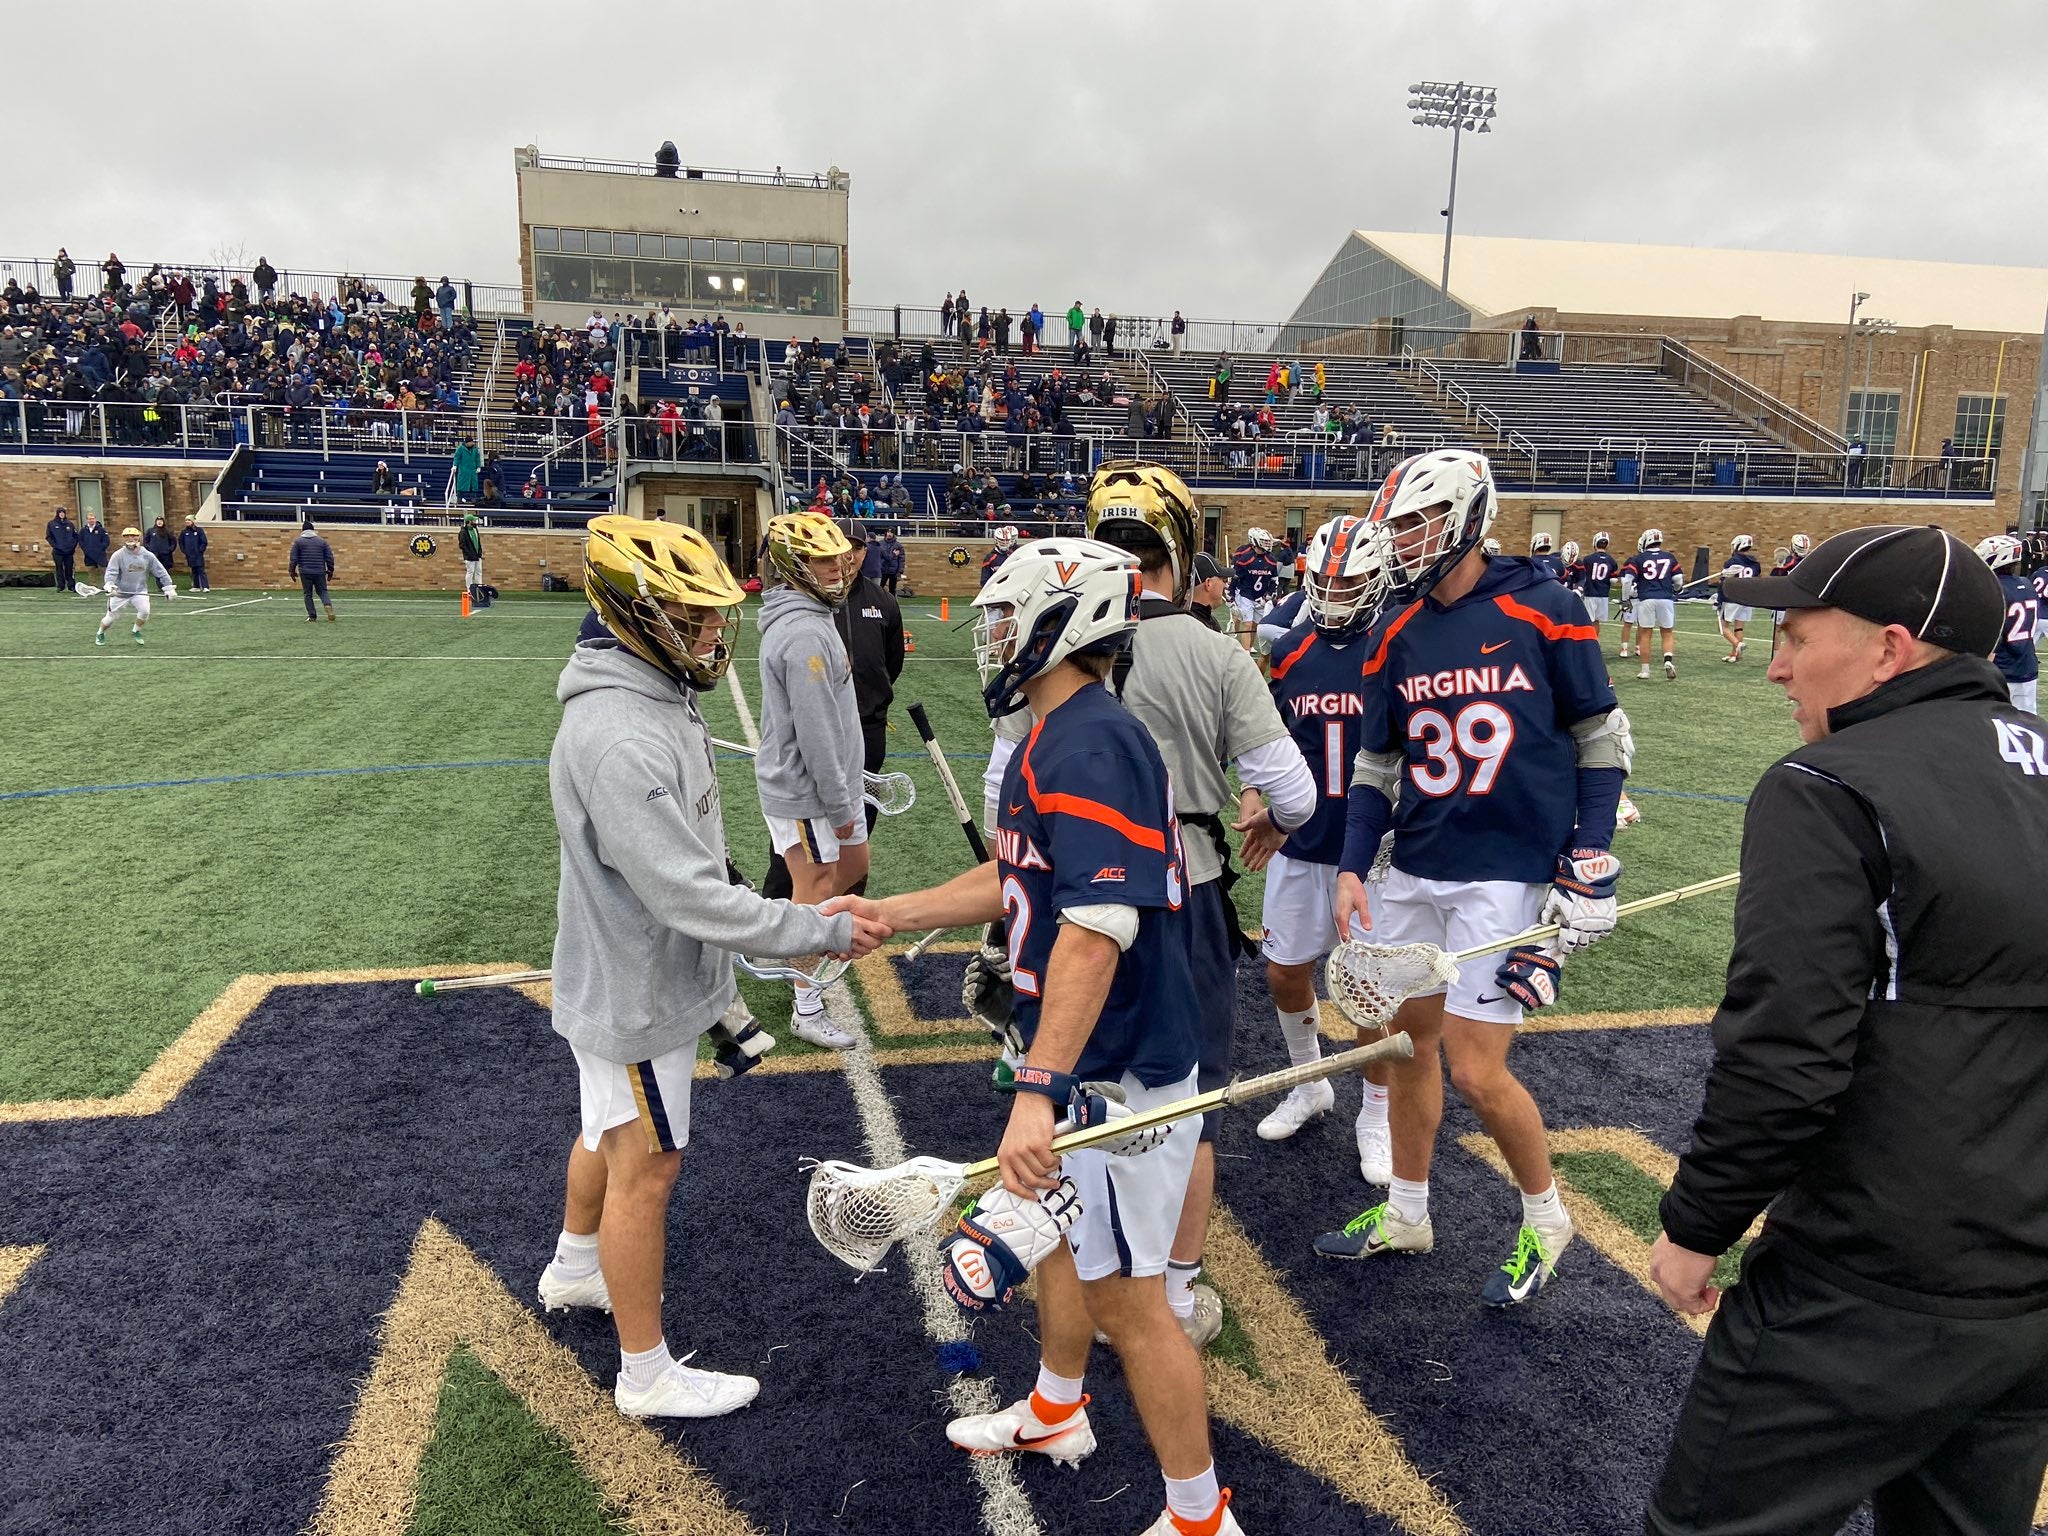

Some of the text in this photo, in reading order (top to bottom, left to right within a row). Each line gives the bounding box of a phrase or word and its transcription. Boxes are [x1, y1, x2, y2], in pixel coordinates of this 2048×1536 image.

[1102, 507, 1138, 517] IRISH
[1591, 562, 1608, 581] 10
[1642, 558, 1671, 580] 37
[1253, 575, 1263, 591] 6
[2033, 576, 2048, 598] 2
[2006, 600, 2038, 642] 27
[1325, 720, 1344, 797] 1
[1408, 701, 1515, 797] 39
[646, 787, 670, 801] ACC
[1093, 867, 1126, 882] ACC
